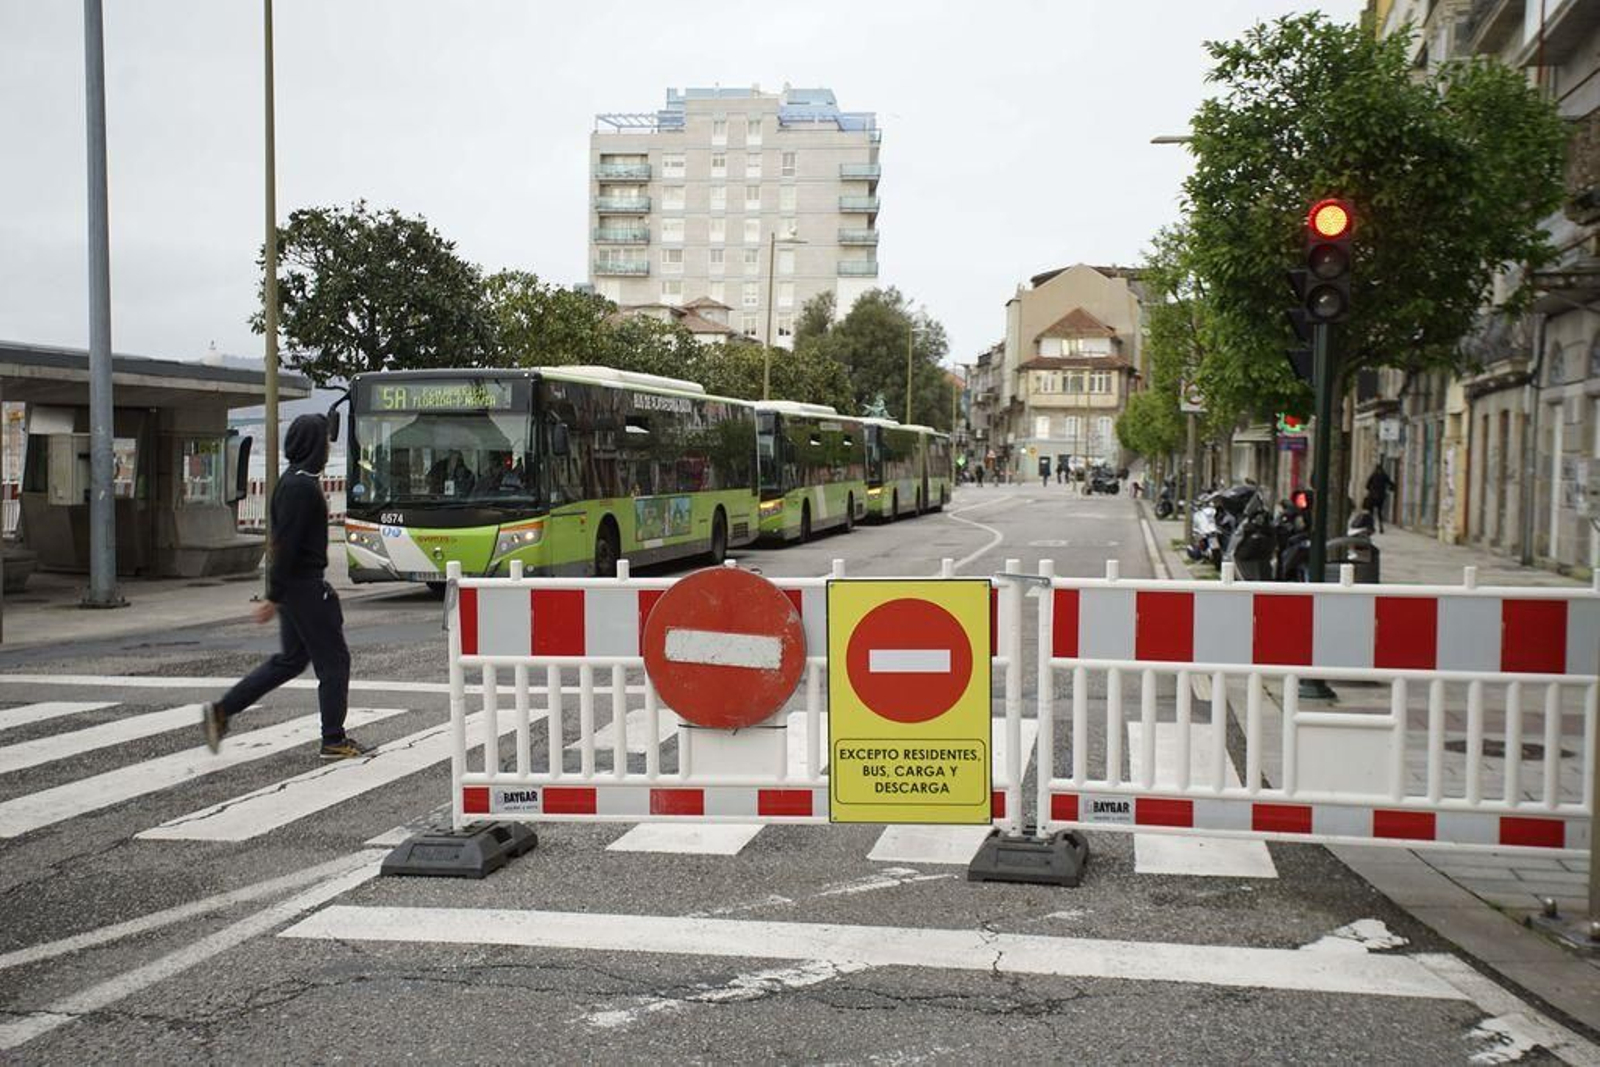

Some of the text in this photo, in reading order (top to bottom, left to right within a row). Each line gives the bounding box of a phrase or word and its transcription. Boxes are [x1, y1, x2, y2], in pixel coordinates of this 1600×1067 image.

[383, 387, 407, 409] 5A
[381, 513, 403, 524] 6574
[839, 748, 981, 761] EXCEPTO RESIDENTES,
[863, 765, 958, 777] BUS, CARGA Y
[874, 782, 950, 794] DESCARGA
[503, 790, 538, 803] BAYGAR
[1093, 801, 1130, 813] BAYGAR
